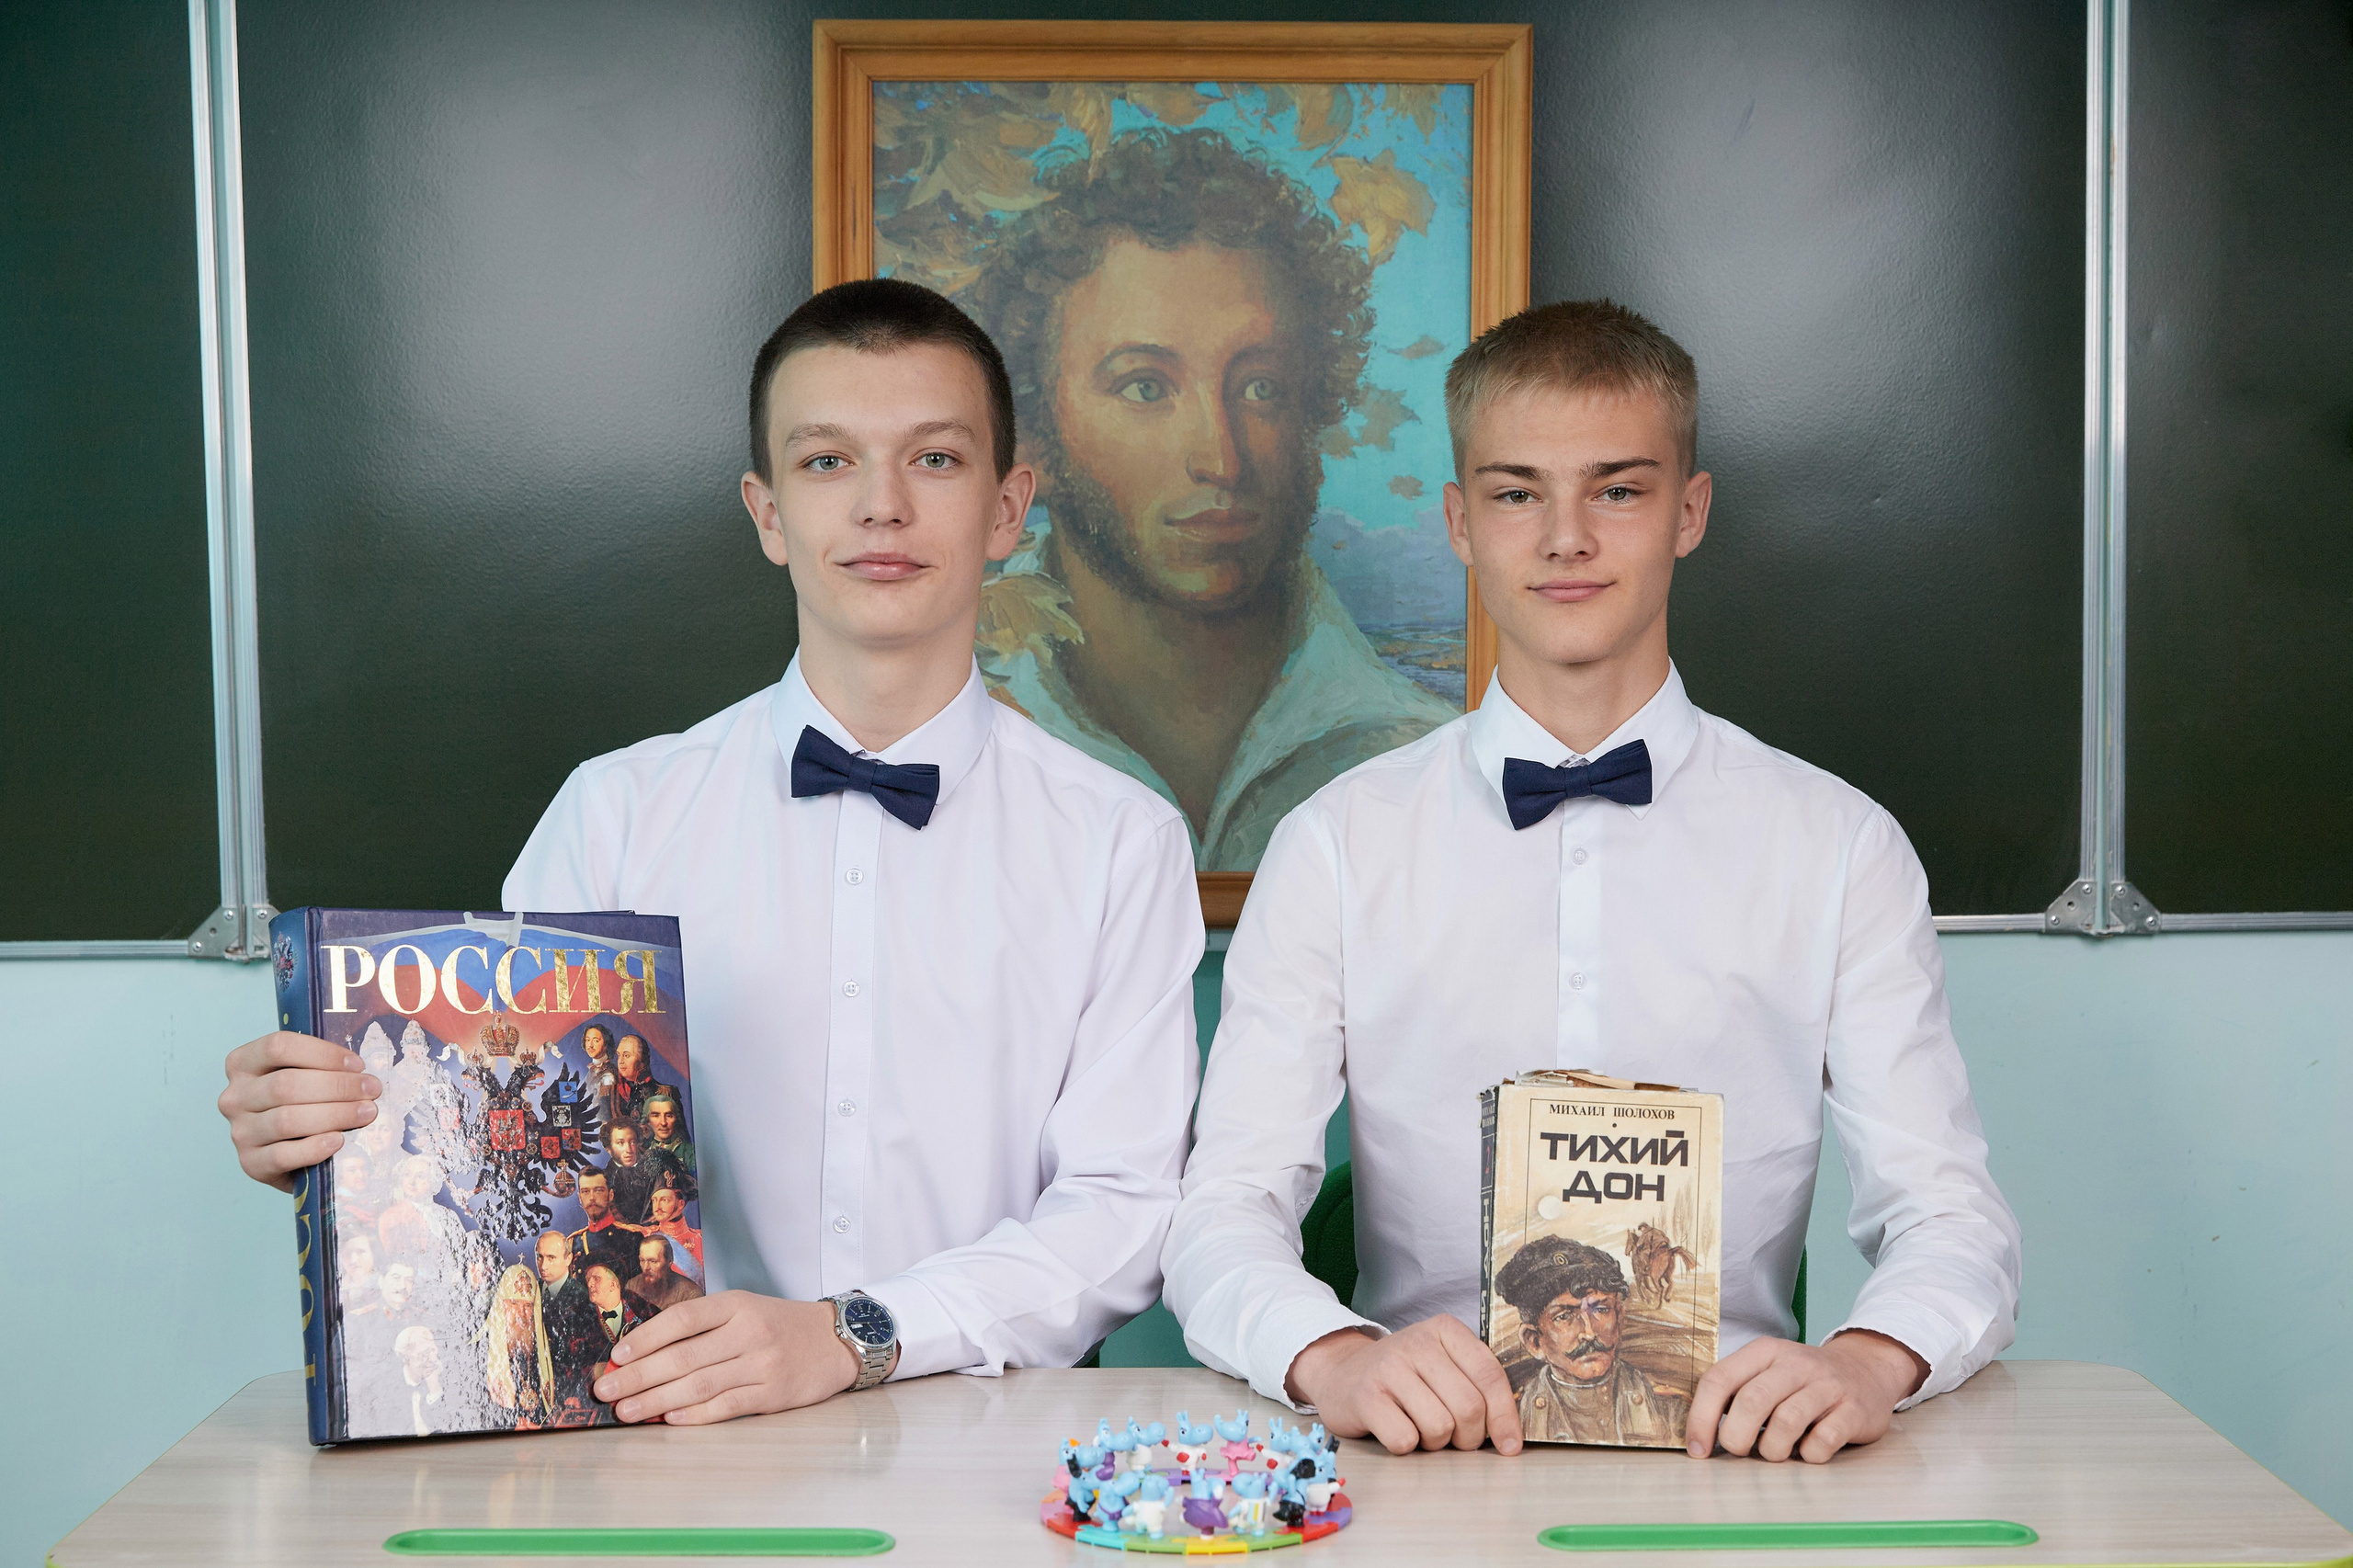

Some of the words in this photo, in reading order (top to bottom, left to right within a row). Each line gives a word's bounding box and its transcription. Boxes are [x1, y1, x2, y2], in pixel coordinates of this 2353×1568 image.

[320, 944, 666, 1015] РОССИЯ
[1549, 1104, 1605, 1117] МИХАИЛ
[1613, 1107, 1676, 1119] ШОЛОХОВ
[1540, 1130, 1688, 1166] ТИХИЙ
[1563, 1170, 1665, 1204] ДОН
